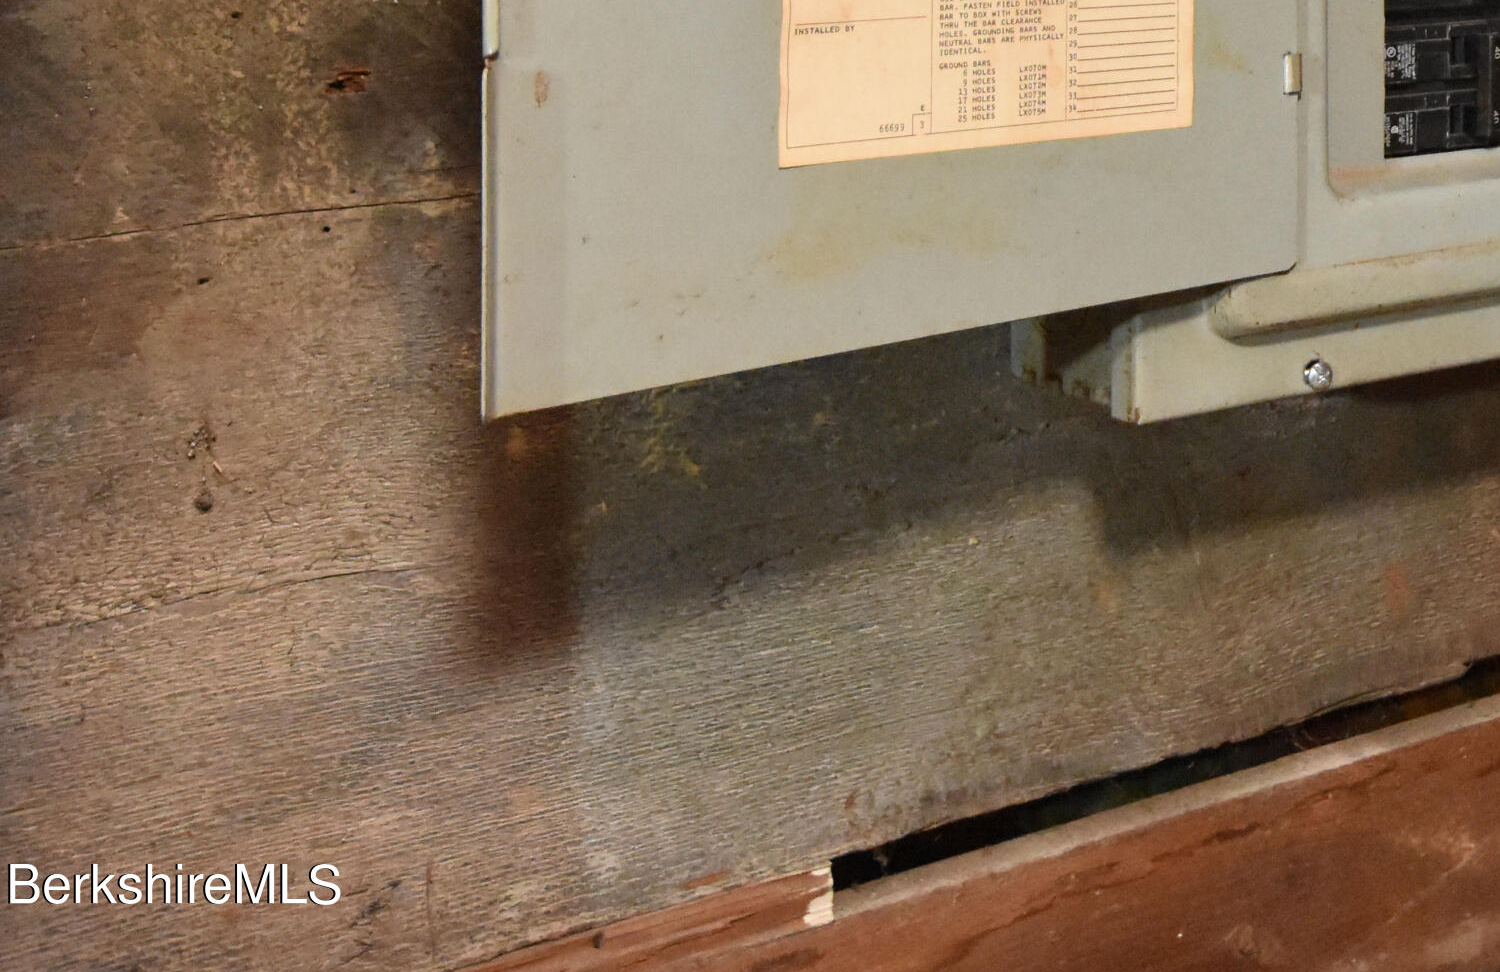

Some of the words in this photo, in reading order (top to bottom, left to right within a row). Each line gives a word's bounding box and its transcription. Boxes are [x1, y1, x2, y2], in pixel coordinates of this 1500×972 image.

[964, 2, 992, 10] FASTEN
[997, 0, 1020, 8] FIELD
[1025, 0, 1064, 7] INSTALLED
[940, 13, 953, 21] BAR
[1001, 17, 1042, 25] CLEARANCE
[794, 26, 840, 36] INSTALLED
[973, 28, 1015, 36] GROUNDING
[1019, 33, 1064, 41] PHYSICALLY
[1494, 46, 1500, 59] 40
[939, 62, 968, 70] GROUND
[972, 68, 996, 76] HOLES
[972, 95, 995, 103] HOLES
